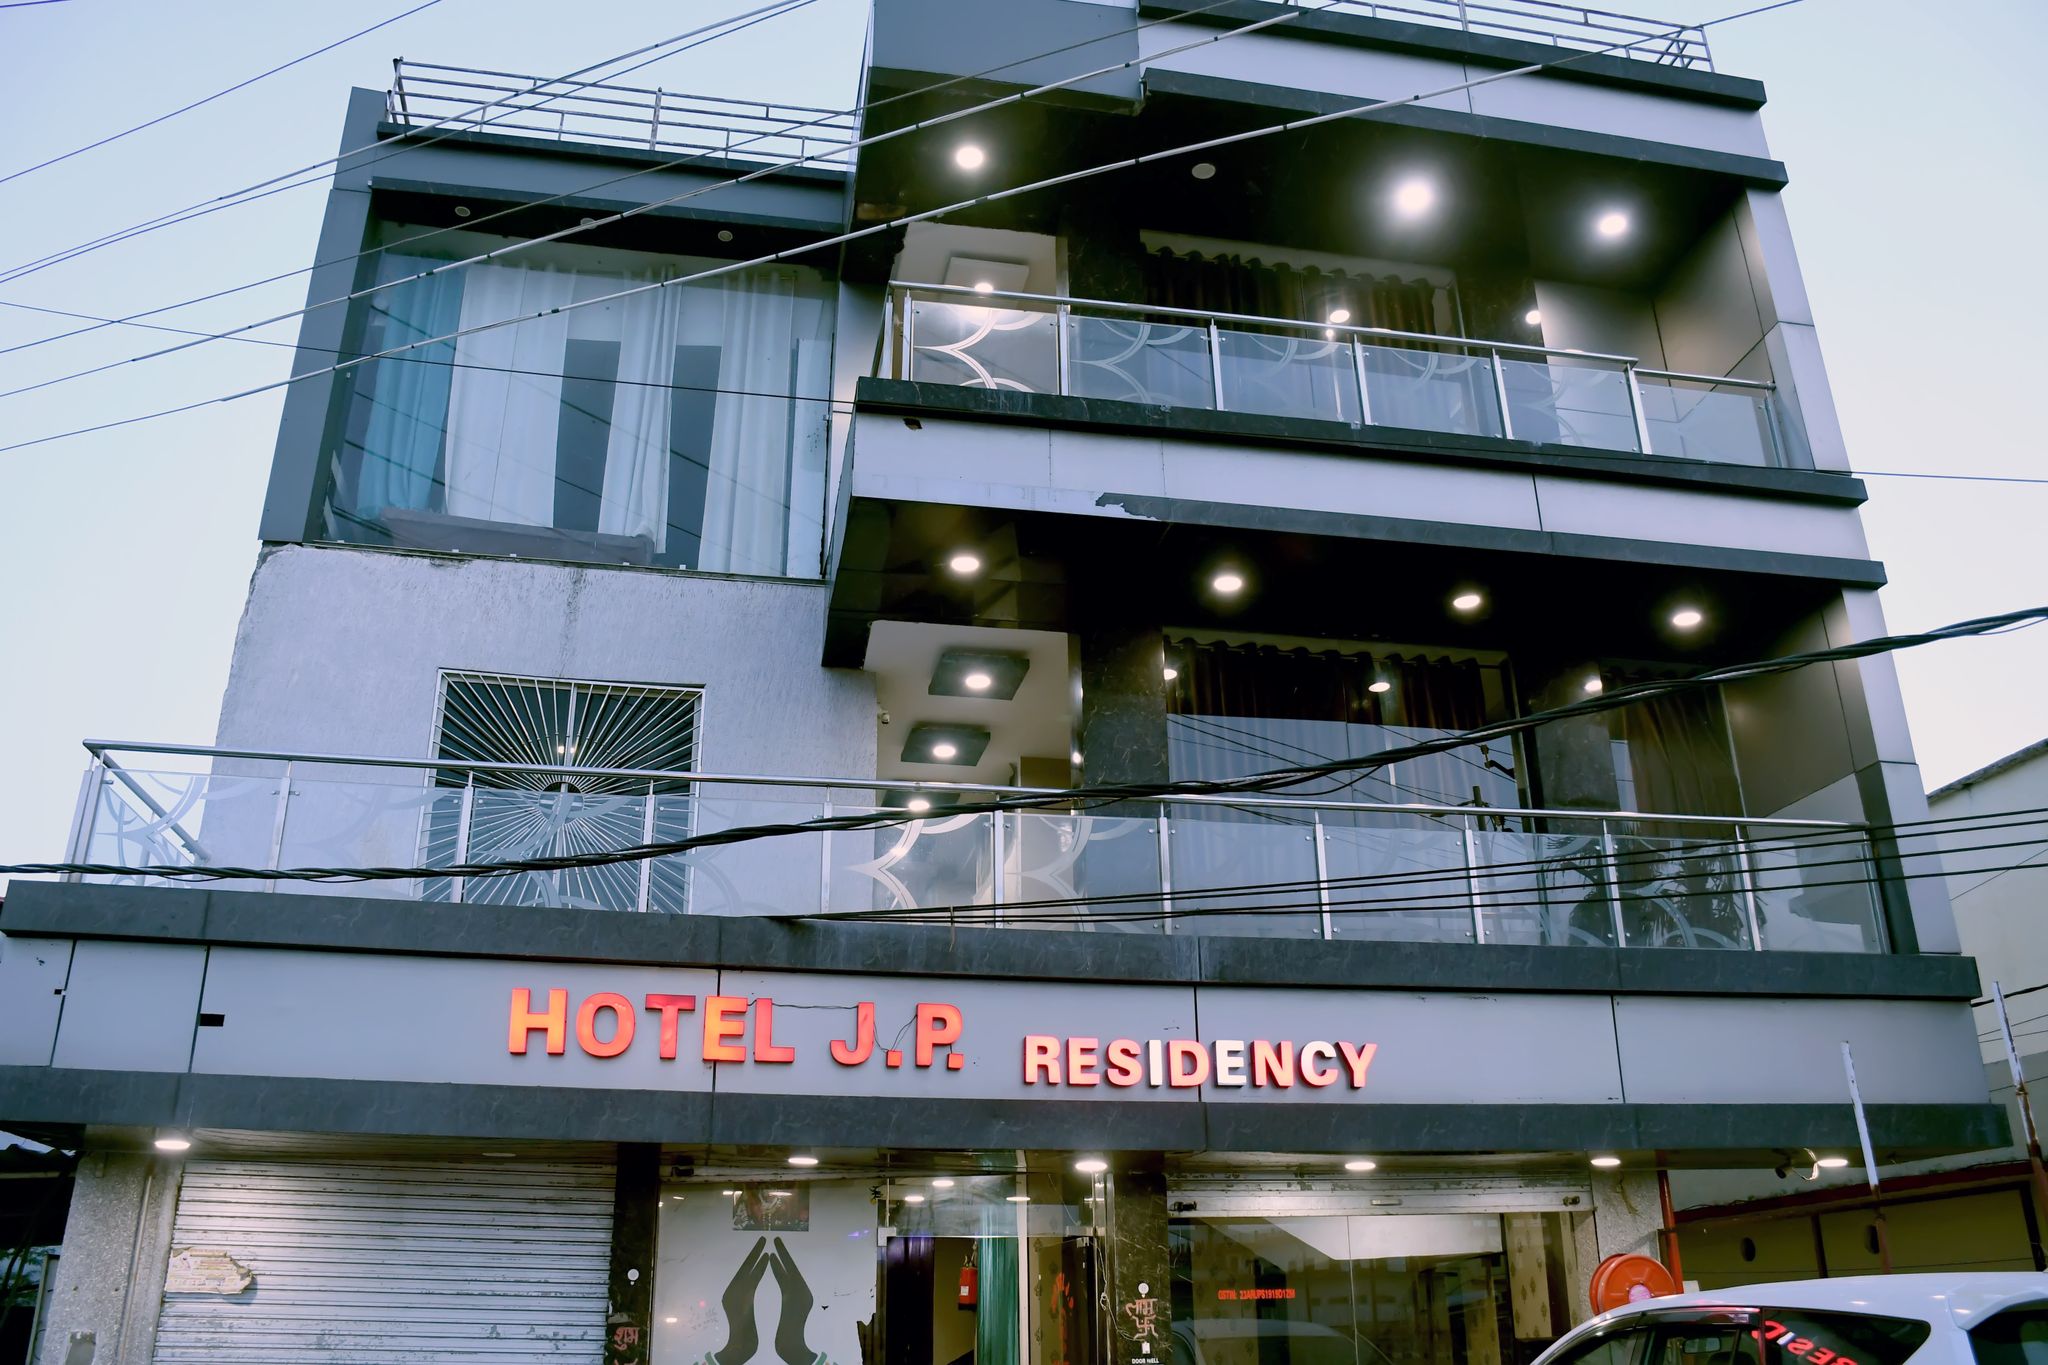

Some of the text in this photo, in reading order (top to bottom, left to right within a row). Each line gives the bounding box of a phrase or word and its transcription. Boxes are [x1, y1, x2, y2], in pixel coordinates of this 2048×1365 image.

[508, 987, 1378, 1088] HOTEL J.P. RESIDENCY
[614, 1327, 640, 1350] शुभ
